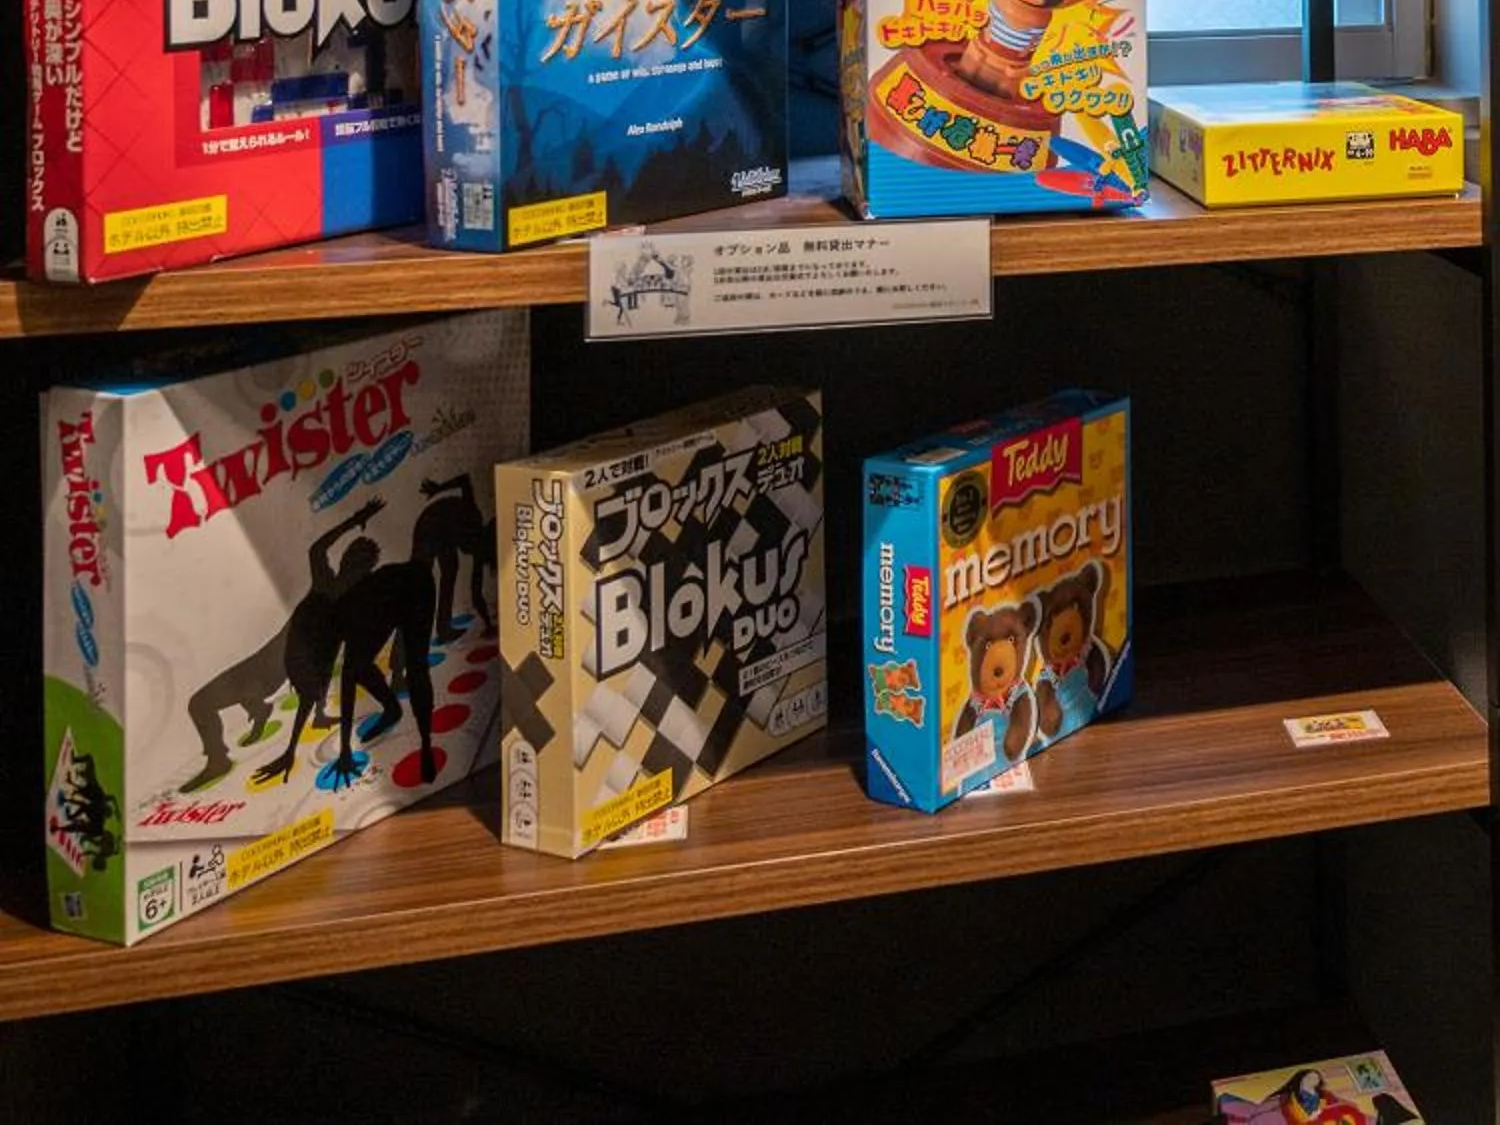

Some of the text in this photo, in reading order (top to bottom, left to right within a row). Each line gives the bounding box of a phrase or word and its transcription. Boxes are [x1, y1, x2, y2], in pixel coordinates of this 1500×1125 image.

[1222, 146, 1336, 178] ZITTERNIX
[1389, 126, 1452, 157] HABA
[714, 241, 791, 256] オプション品
[144, 359, 422, 539] Twister
[1003, 431, 1070, 484] Teddy
[57, 411, 102, 587] Twister
[597, 450, 754, 563] ブロックス
[514, 503, 533, 626] Blokus DUO
[532, 478, 564, 613] ブロックス
[944, 493, 1125, 608] memory
[599, 529, 809, 677] Blokus
[733, 600, 798, 652] DUO
[874, 542, 896, 655] memory
[911, 576, 929, 627] Teddy
[137, 798, 246, 829] Twister
[146, 898, 167, 921] 6+
